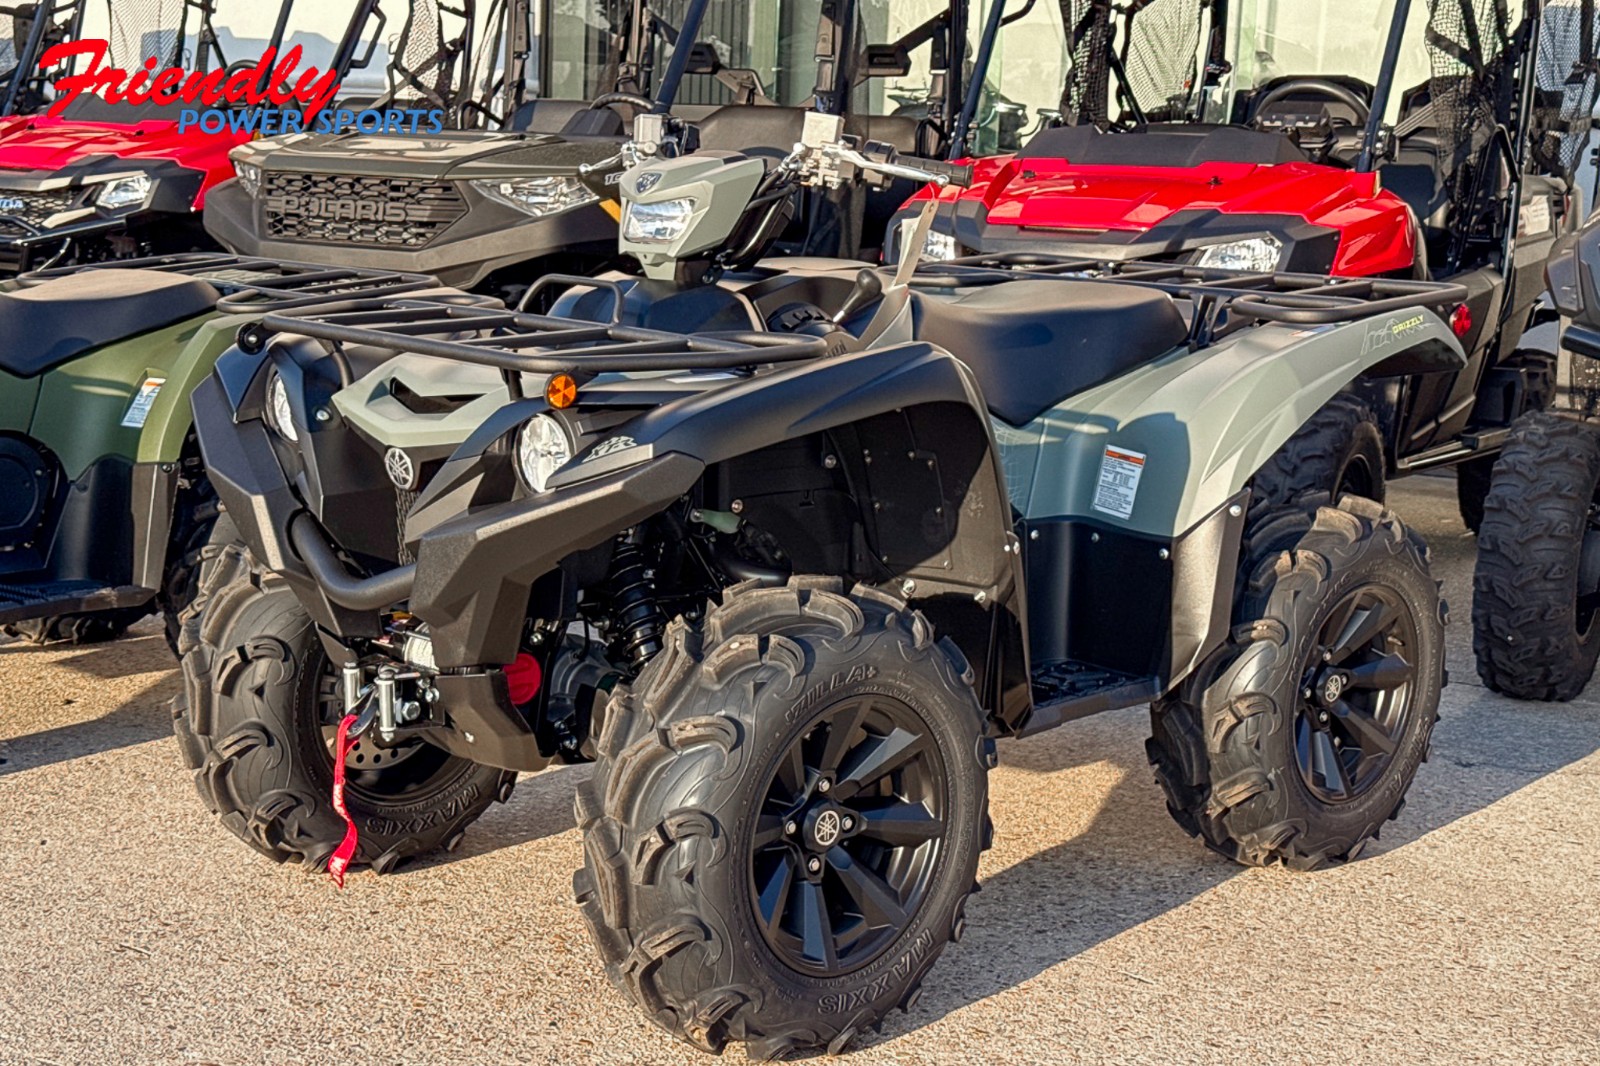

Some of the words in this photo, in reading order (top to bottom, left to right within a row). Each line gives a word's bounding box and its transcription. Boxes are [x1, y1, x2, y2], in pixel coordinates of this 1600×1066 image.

[281, 195, 406, 222] POLARIS
[1392, 315, 1424, 335] GRIZZLY
[365, 783, 480, 836] MAXXIS
[817, 927, 935, 1015] MAXXIS
